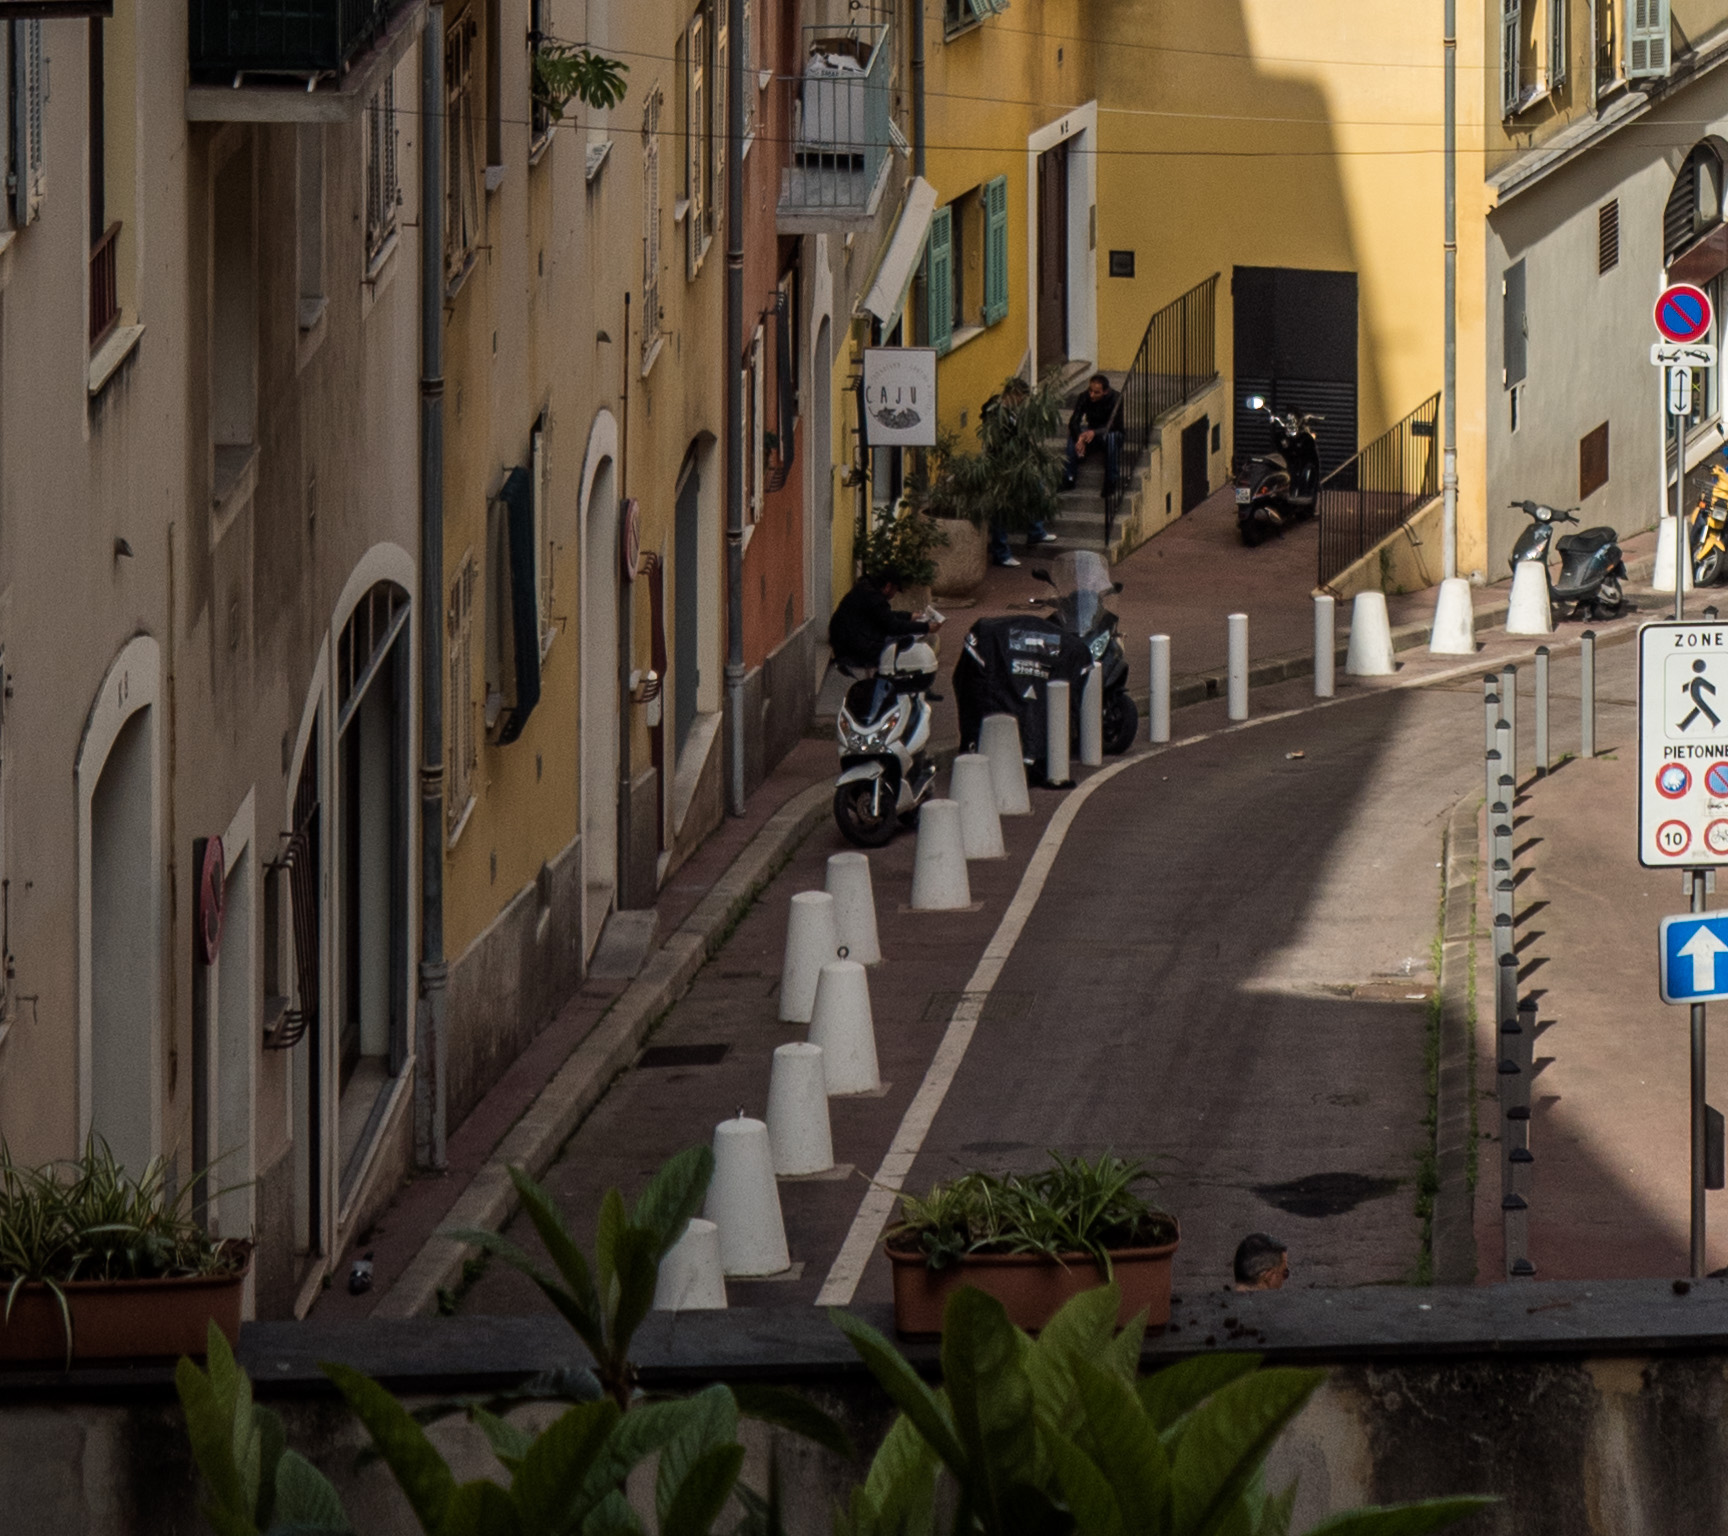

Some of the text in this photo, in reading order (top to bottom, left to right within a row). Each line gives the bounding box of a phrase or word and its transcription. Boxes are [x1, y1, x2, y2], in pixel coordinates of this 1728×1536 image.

[866, 385, 917, 404] CAJU
[1675, 633, 1723, 647] ZONE
[1664, 832, 1683, 846] 10
